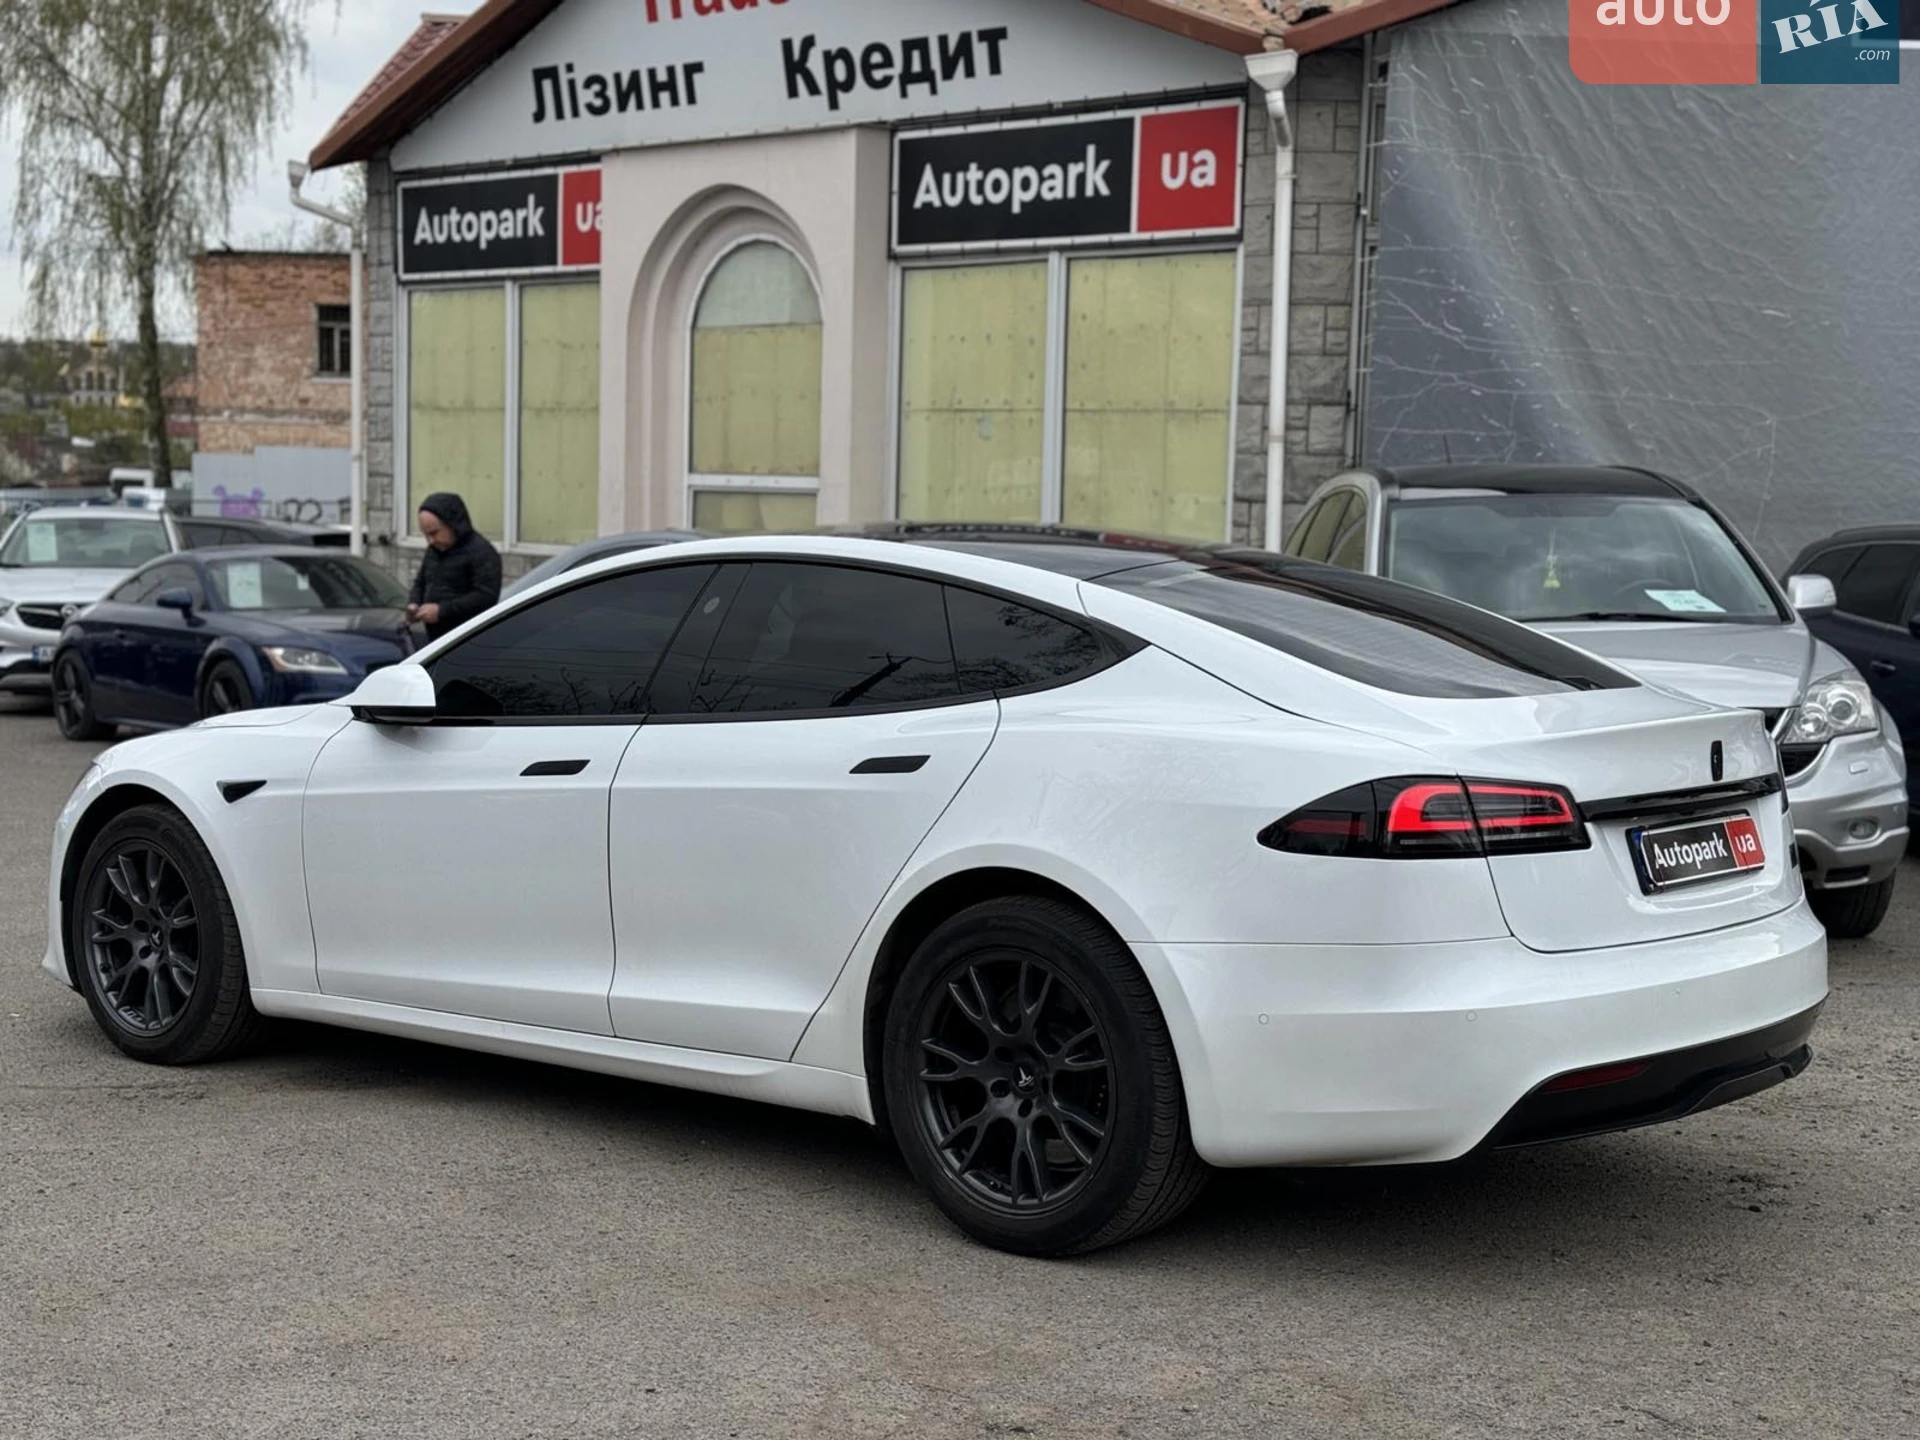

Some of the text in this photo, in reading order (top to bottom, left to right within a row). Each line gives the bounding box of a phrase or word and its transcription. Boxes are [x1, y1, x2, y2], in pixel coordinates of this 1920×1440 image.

[531, 26, 1008, 124] Лізинг Кредит
[912, 143, 1217, 215] Autopark ua
[413, 193, 546, 250] Autopark
[1653, 831, 1757, 870] Autopark ua
